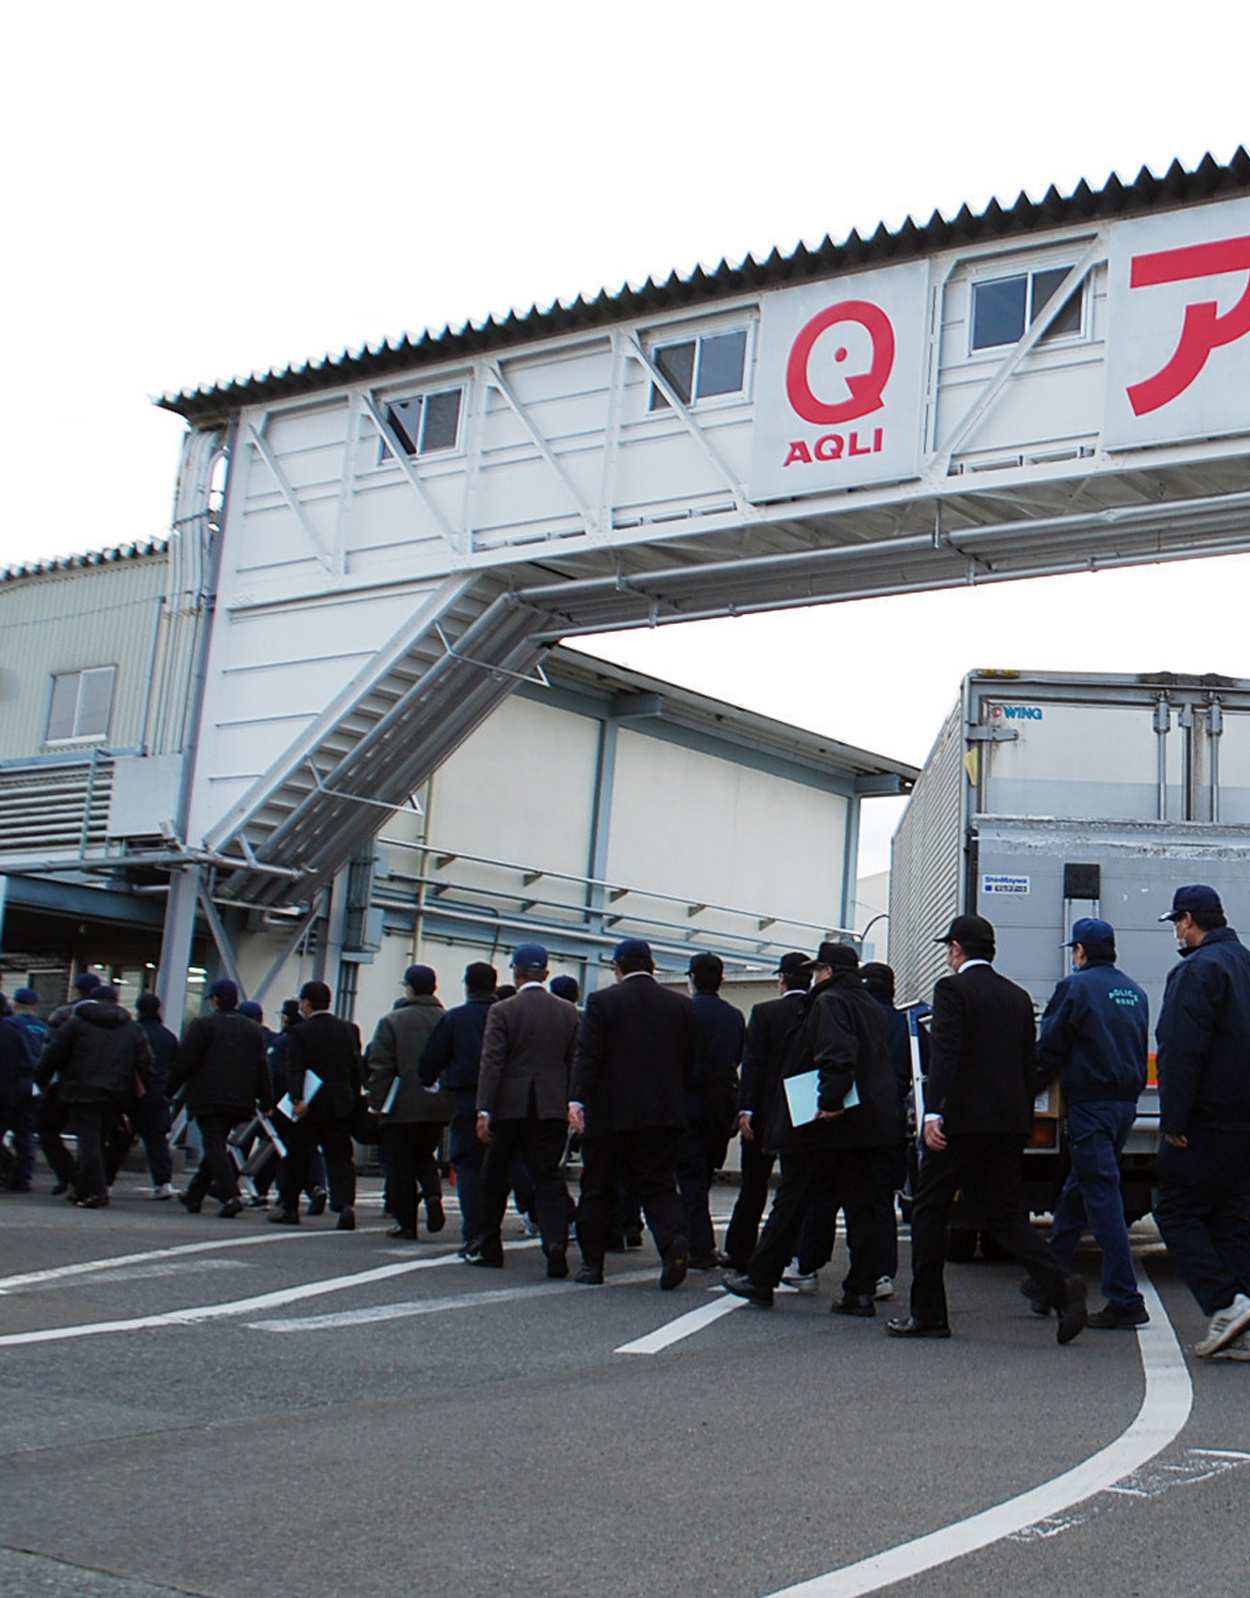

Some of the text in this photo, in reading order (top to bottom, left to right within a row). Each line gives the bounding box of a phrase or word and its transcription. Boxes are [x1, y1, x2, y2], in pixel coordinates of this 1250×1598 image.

[784, 428, 883, 467] AQLI
[1004, 704, 1042, 720] WING
[1108, 988, 1138, 1002] POLICE
